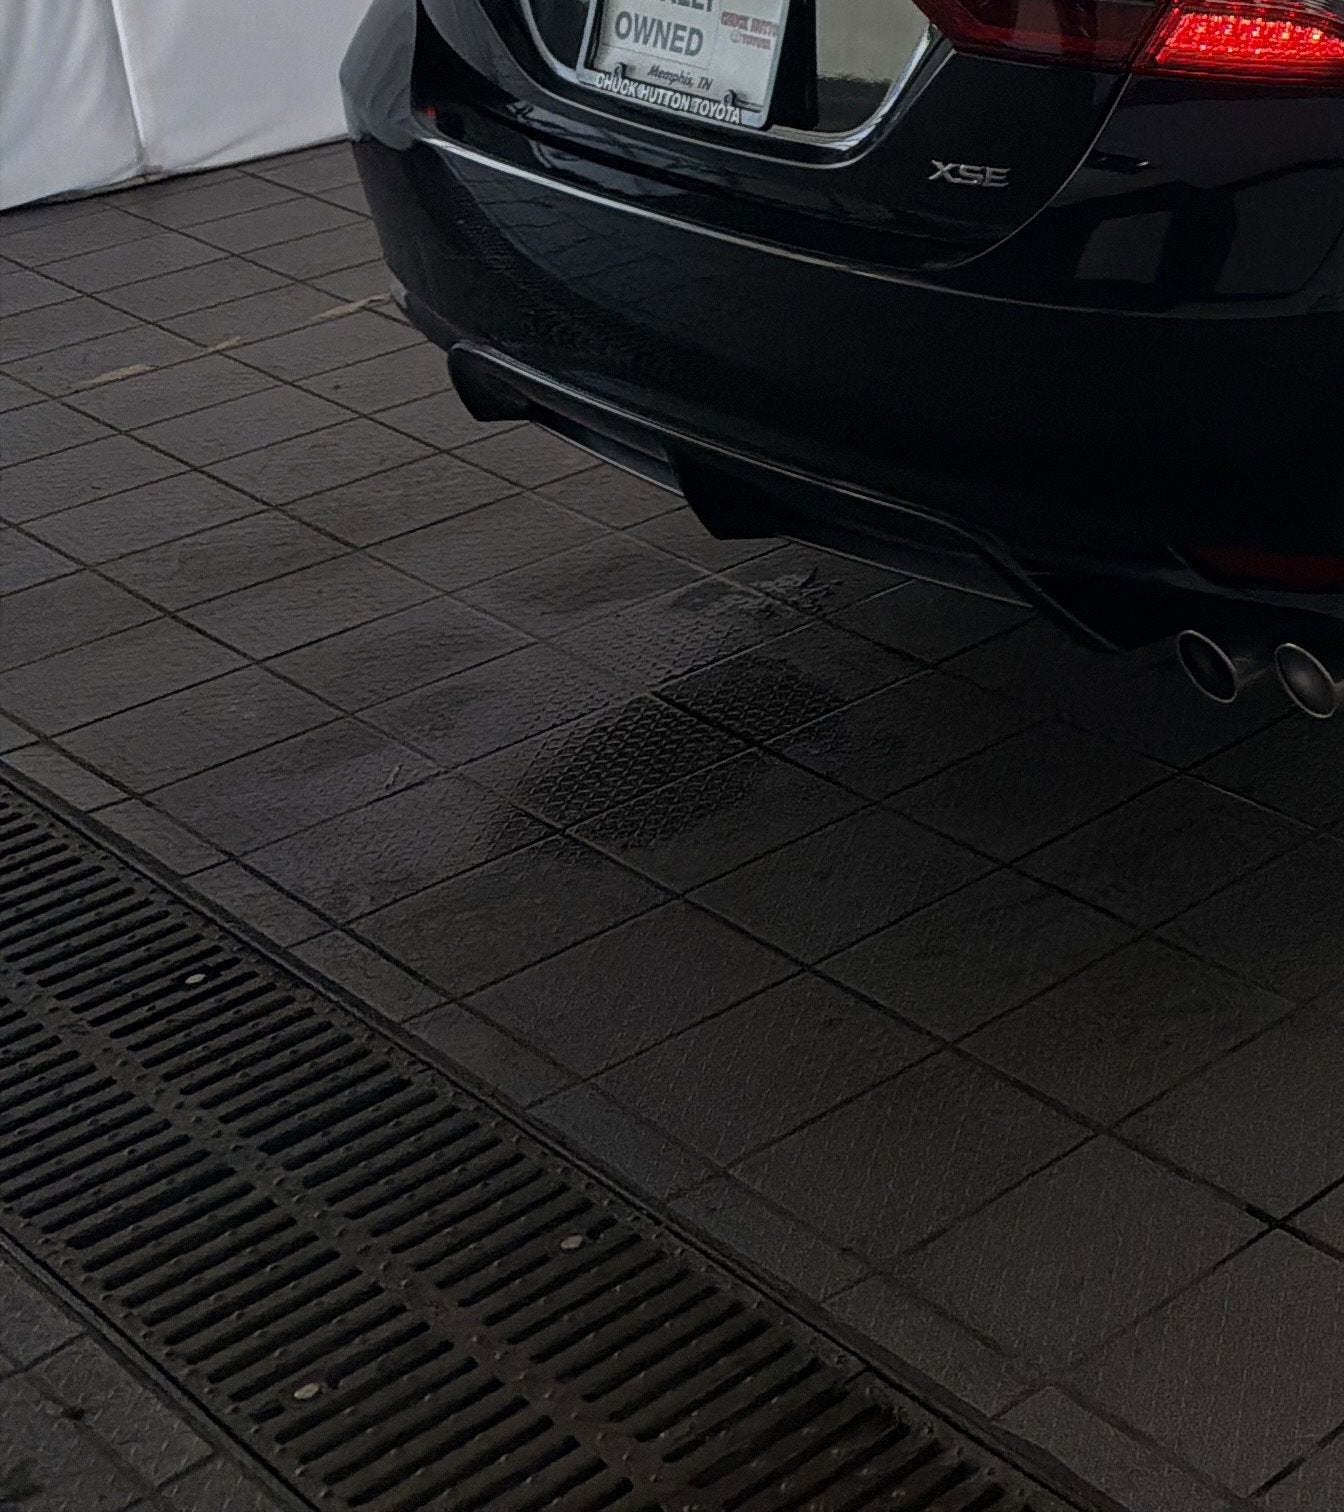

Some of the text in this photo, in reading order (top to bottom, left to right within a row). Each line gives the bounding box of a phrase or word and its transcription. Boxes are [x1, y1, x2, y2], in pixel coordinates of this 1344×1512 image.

[614, 10, 704, 57] OWNED
[647, 64, 714, 91] Memphis, TN
[595, 73, 741, 124] CHUCK HUTTON TOYOTA
[928, 159, 1011, 187] XSE
